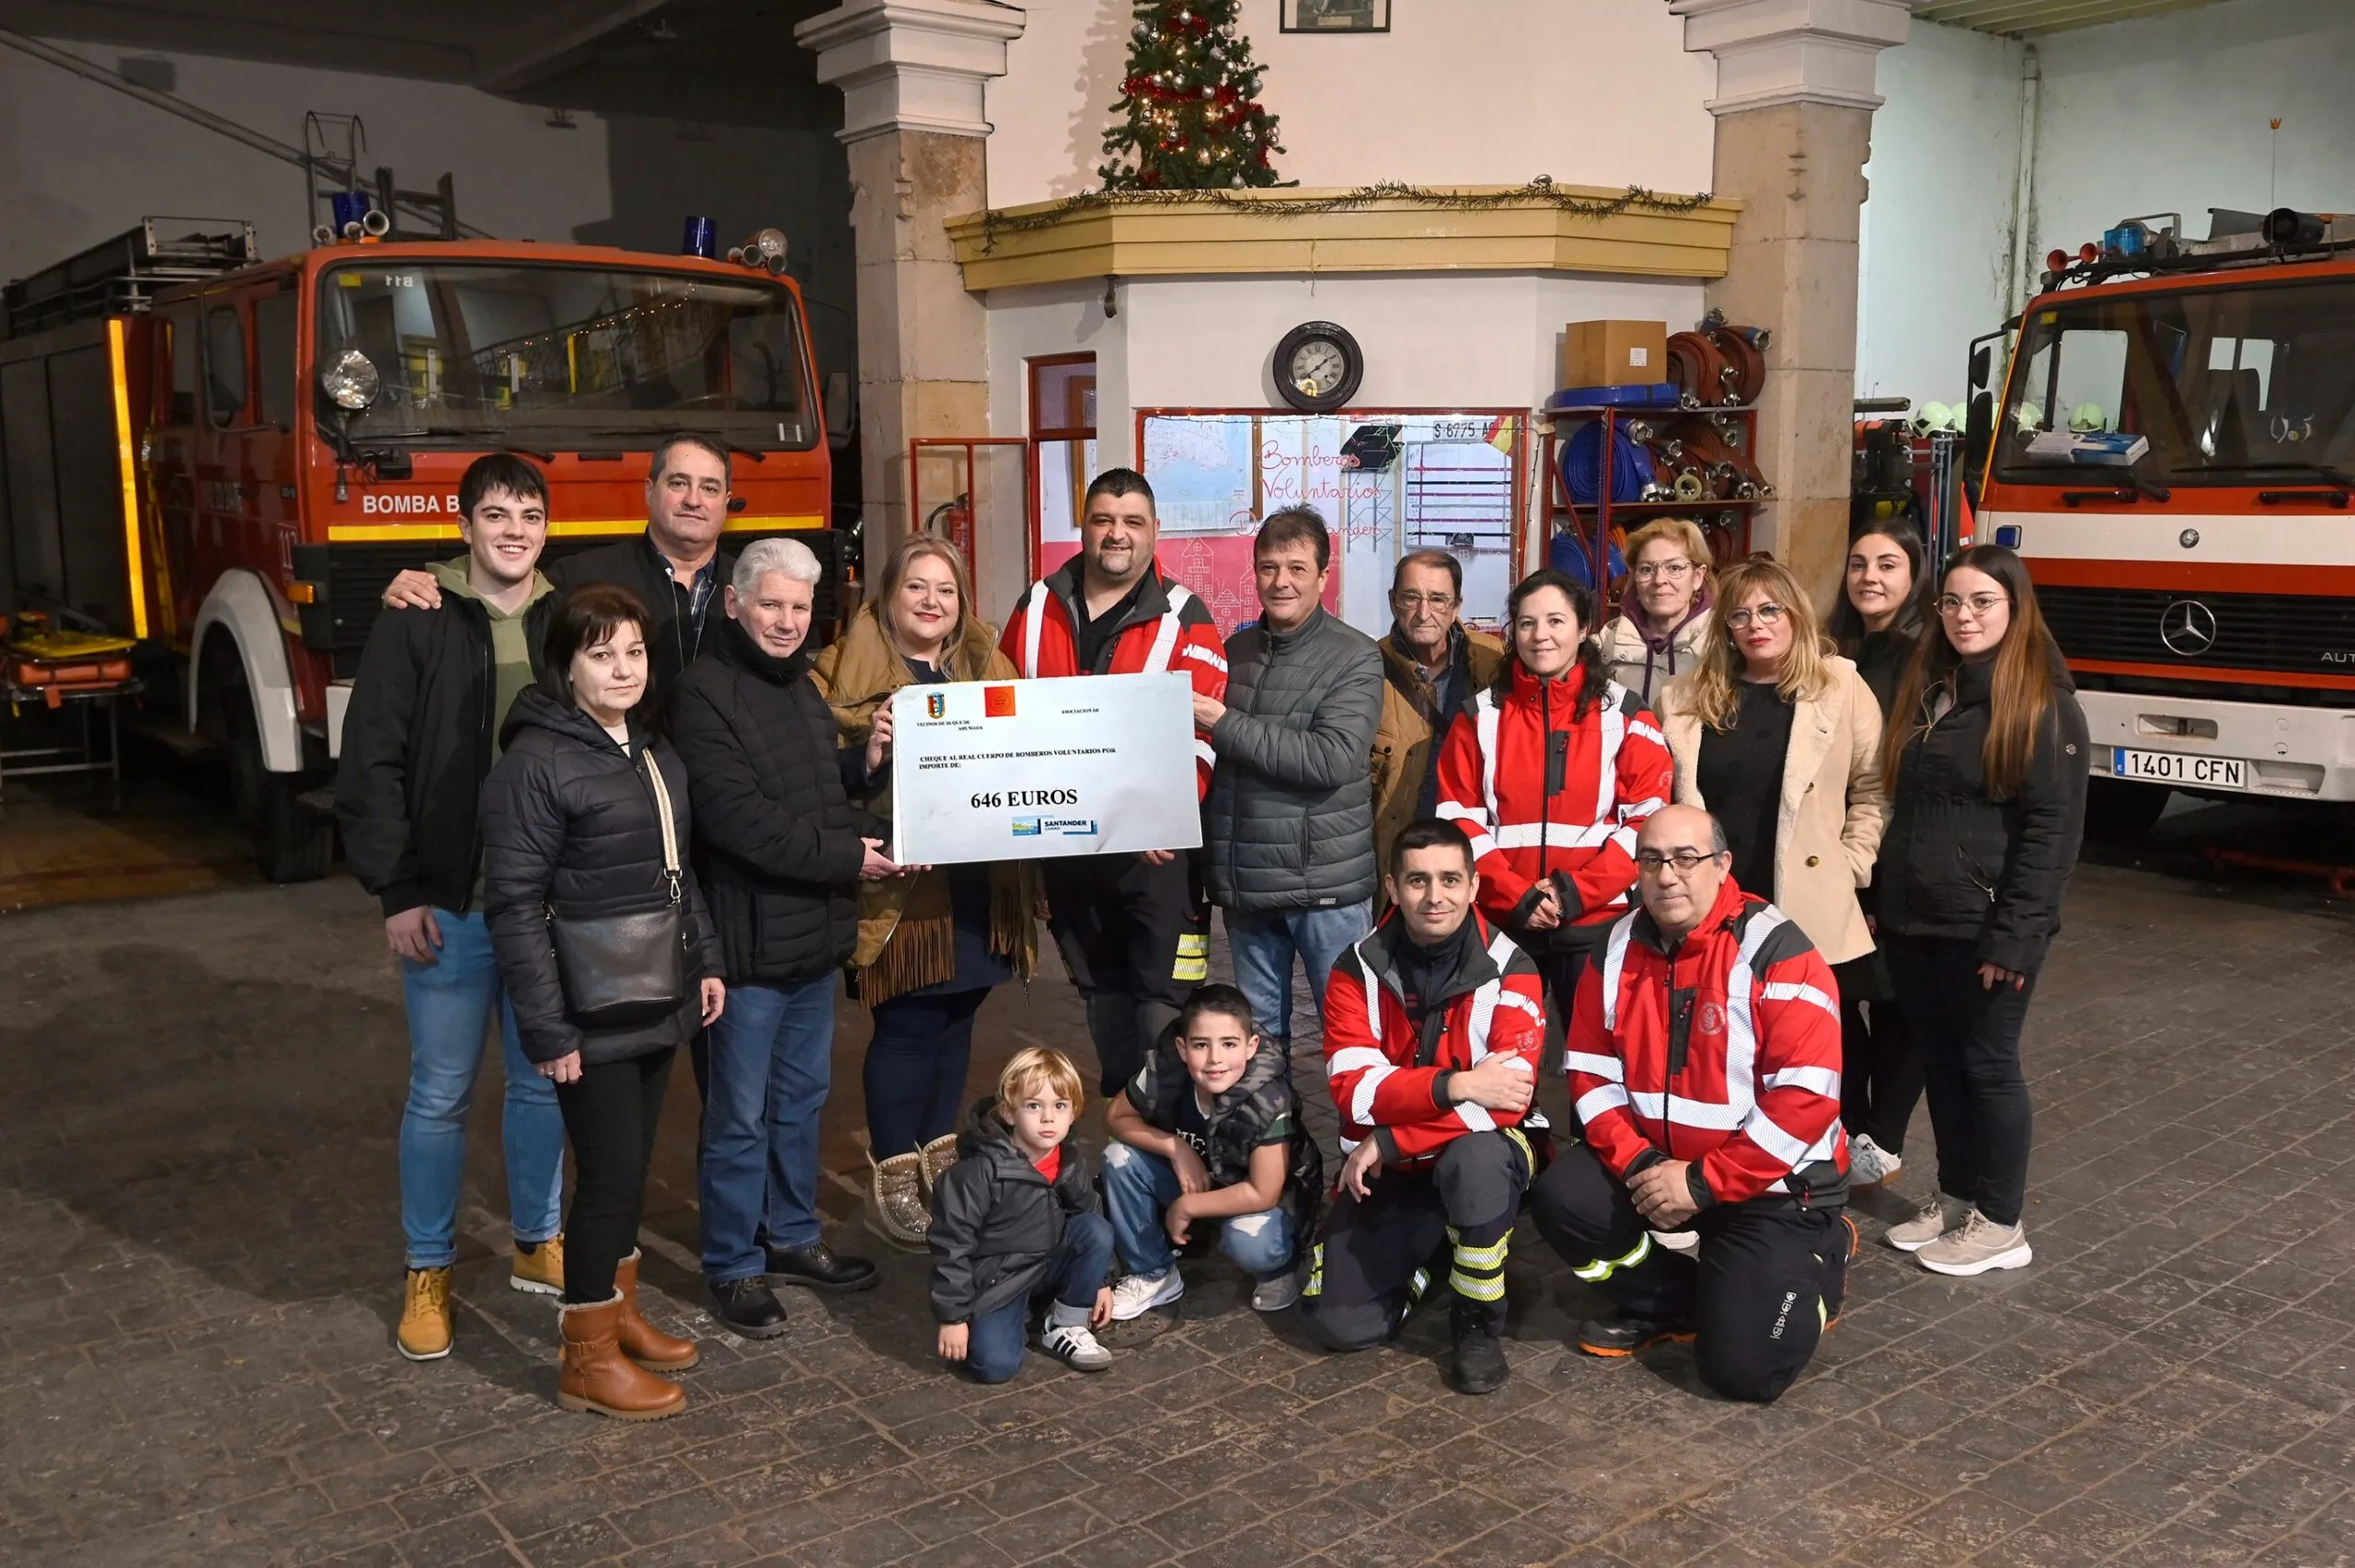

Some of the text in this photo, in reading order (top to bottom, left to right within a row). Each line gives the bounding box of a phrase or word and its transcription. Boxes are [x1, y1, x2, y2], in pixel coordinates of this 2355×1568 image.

[1257, 441, 1361, 470] Bomberos
[1260, 466, 1381, 499] Voluntarios
[362, 495, 441, 514] BOMBA
[1053, 748, 1101, 756] VOLUNTARIOS
[2131, 753, 2239, 784] 1401 CFN
[971, 789, 1078, 808] 646 EUROS
